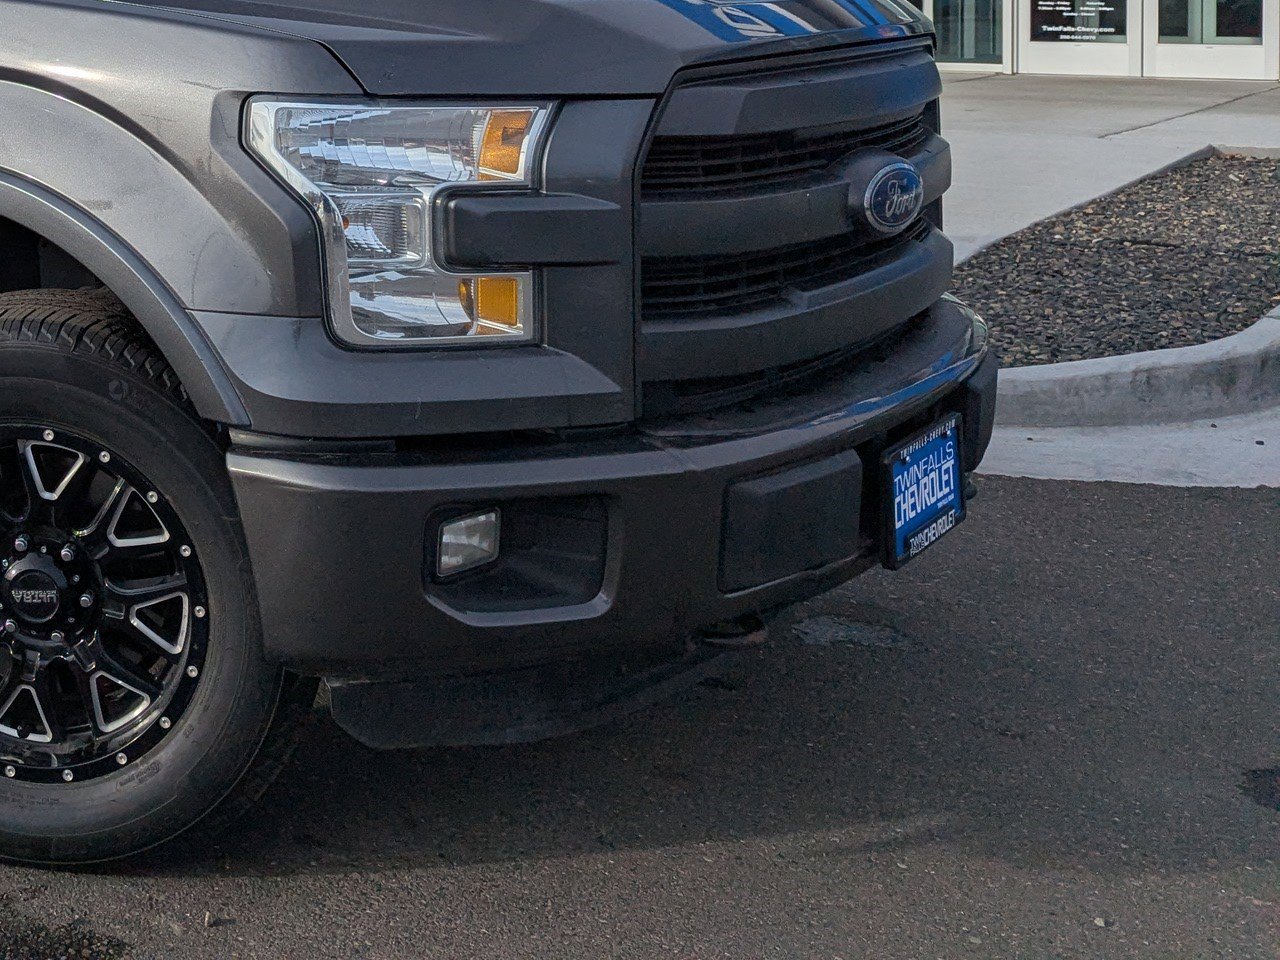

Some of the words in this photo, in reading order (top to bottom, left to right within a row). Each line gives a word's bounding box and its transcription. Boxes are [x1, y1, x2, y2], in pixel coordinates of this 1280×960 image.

[885, 179, 916, 218] Ford
[894, 458, 955, 529] CHEVROLET
[923, 509, 955, 547] CHEVROLET
[13, 594, 57, 603] ULTRA
